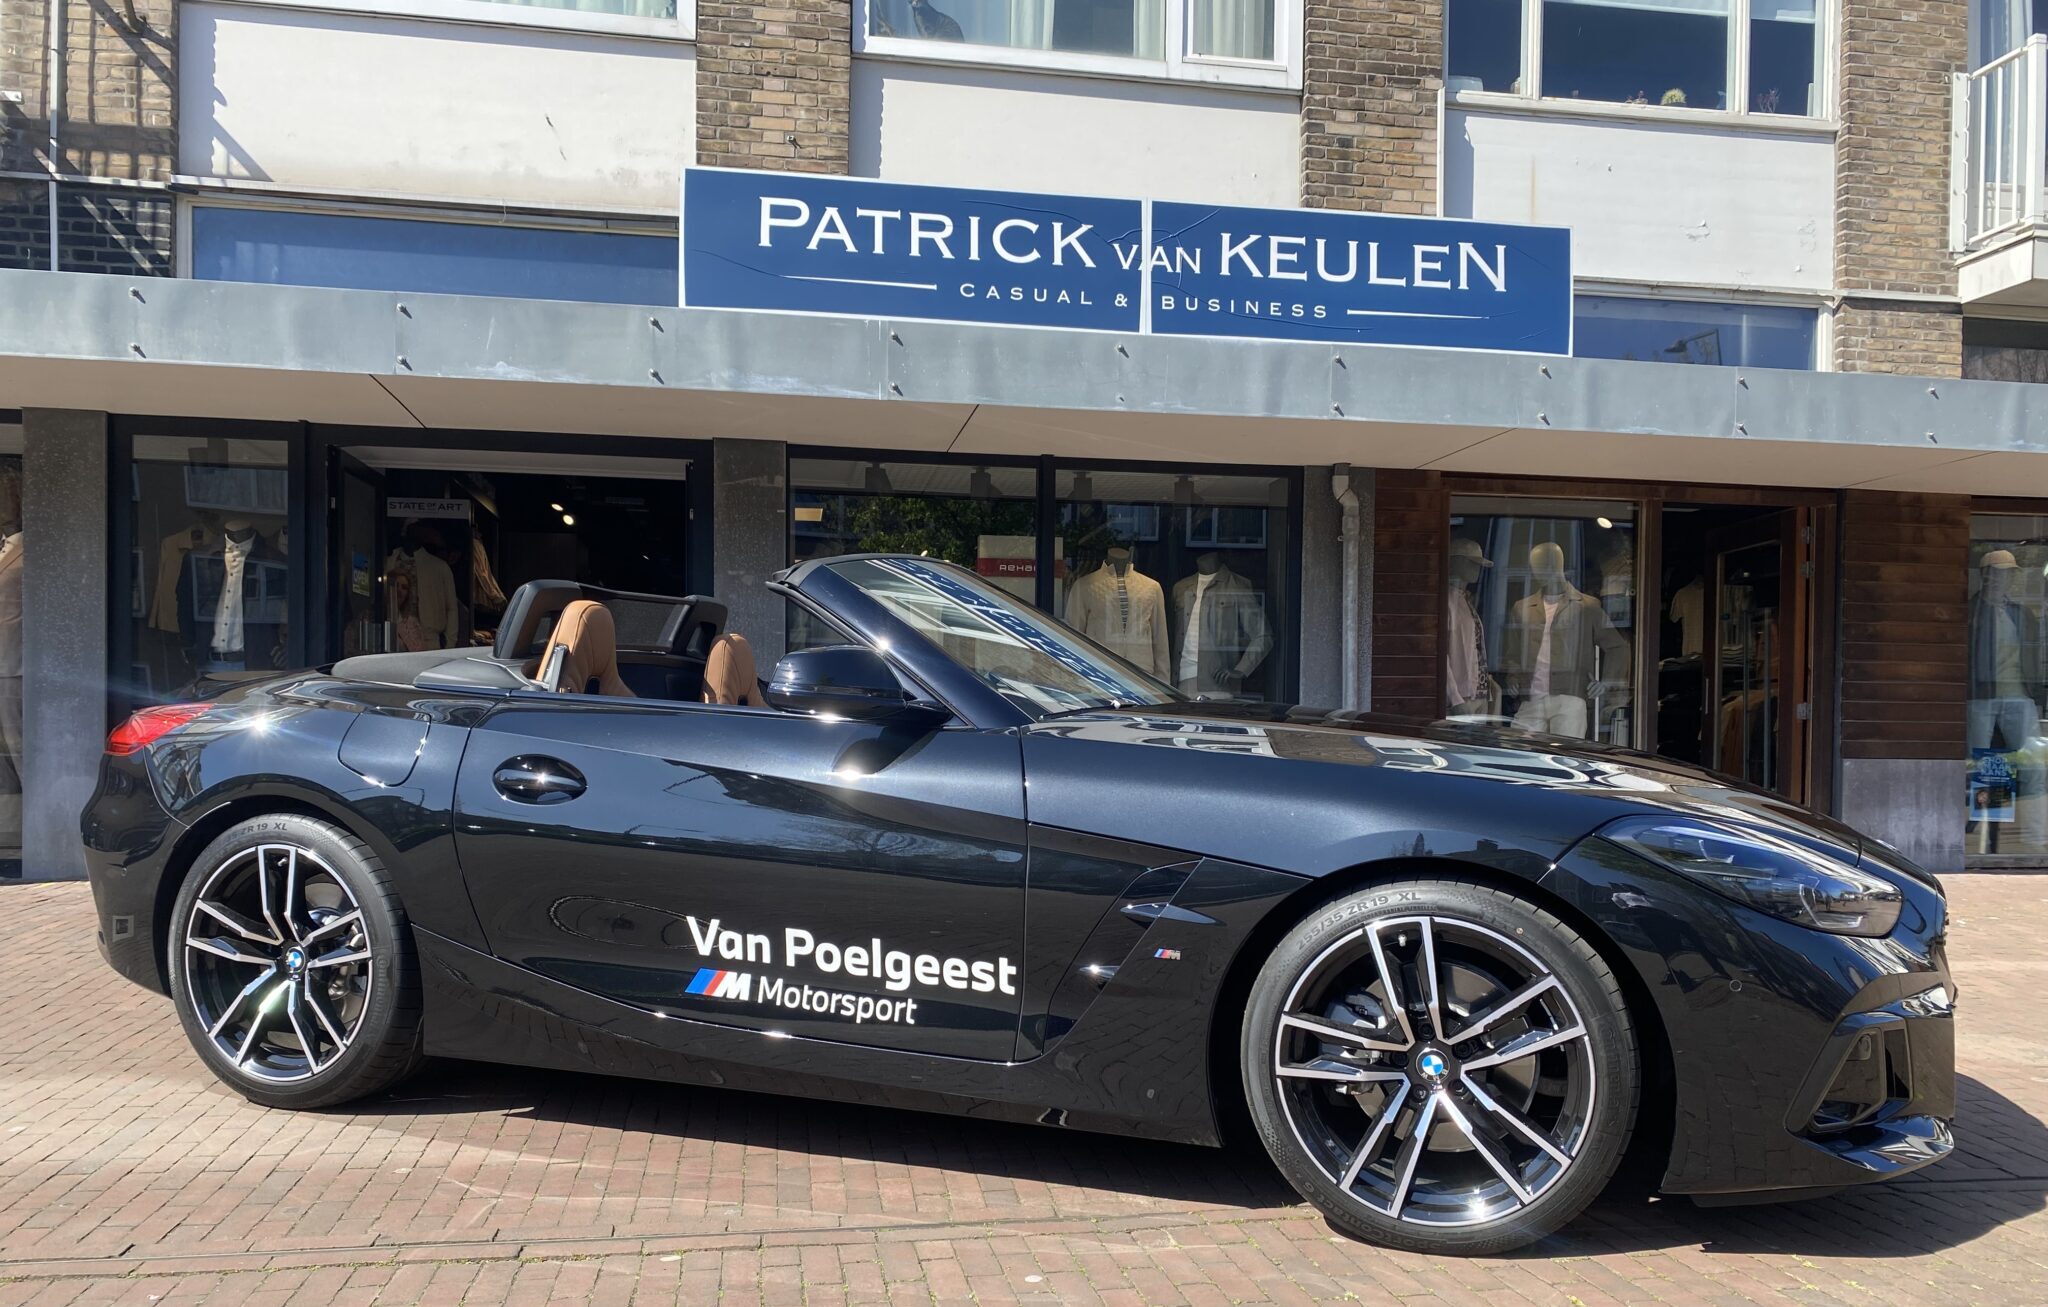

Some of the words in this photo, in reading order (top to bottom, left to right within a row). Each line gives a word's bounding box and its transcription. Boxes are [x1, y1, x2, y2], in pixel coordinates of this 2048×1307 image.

[758, 196, 1097, 268] PATRICK
[1112, 243, 1201, 274] VAN
[1219, 232, 1507, 292] KEULEN
[959, 283, 1093, 305] CASUAL
[1114, 293, 1128, 308] &
[1161, 295, 1327, 319] BUSINESS
[389, 501, 425, 511] STATE
[438, 503, 463, 512] ART
[999, 564, 1036, 572] REHA
[257, 822, 269, 832] 19
[273, 822, 288, 831] XL
[1397, 891, 1422, 903] XL
[686, 915, 772, 965] Van
[784, 927, 1017, 996] Poelgeest
[757, 975, 918, 1025] Motorsport
